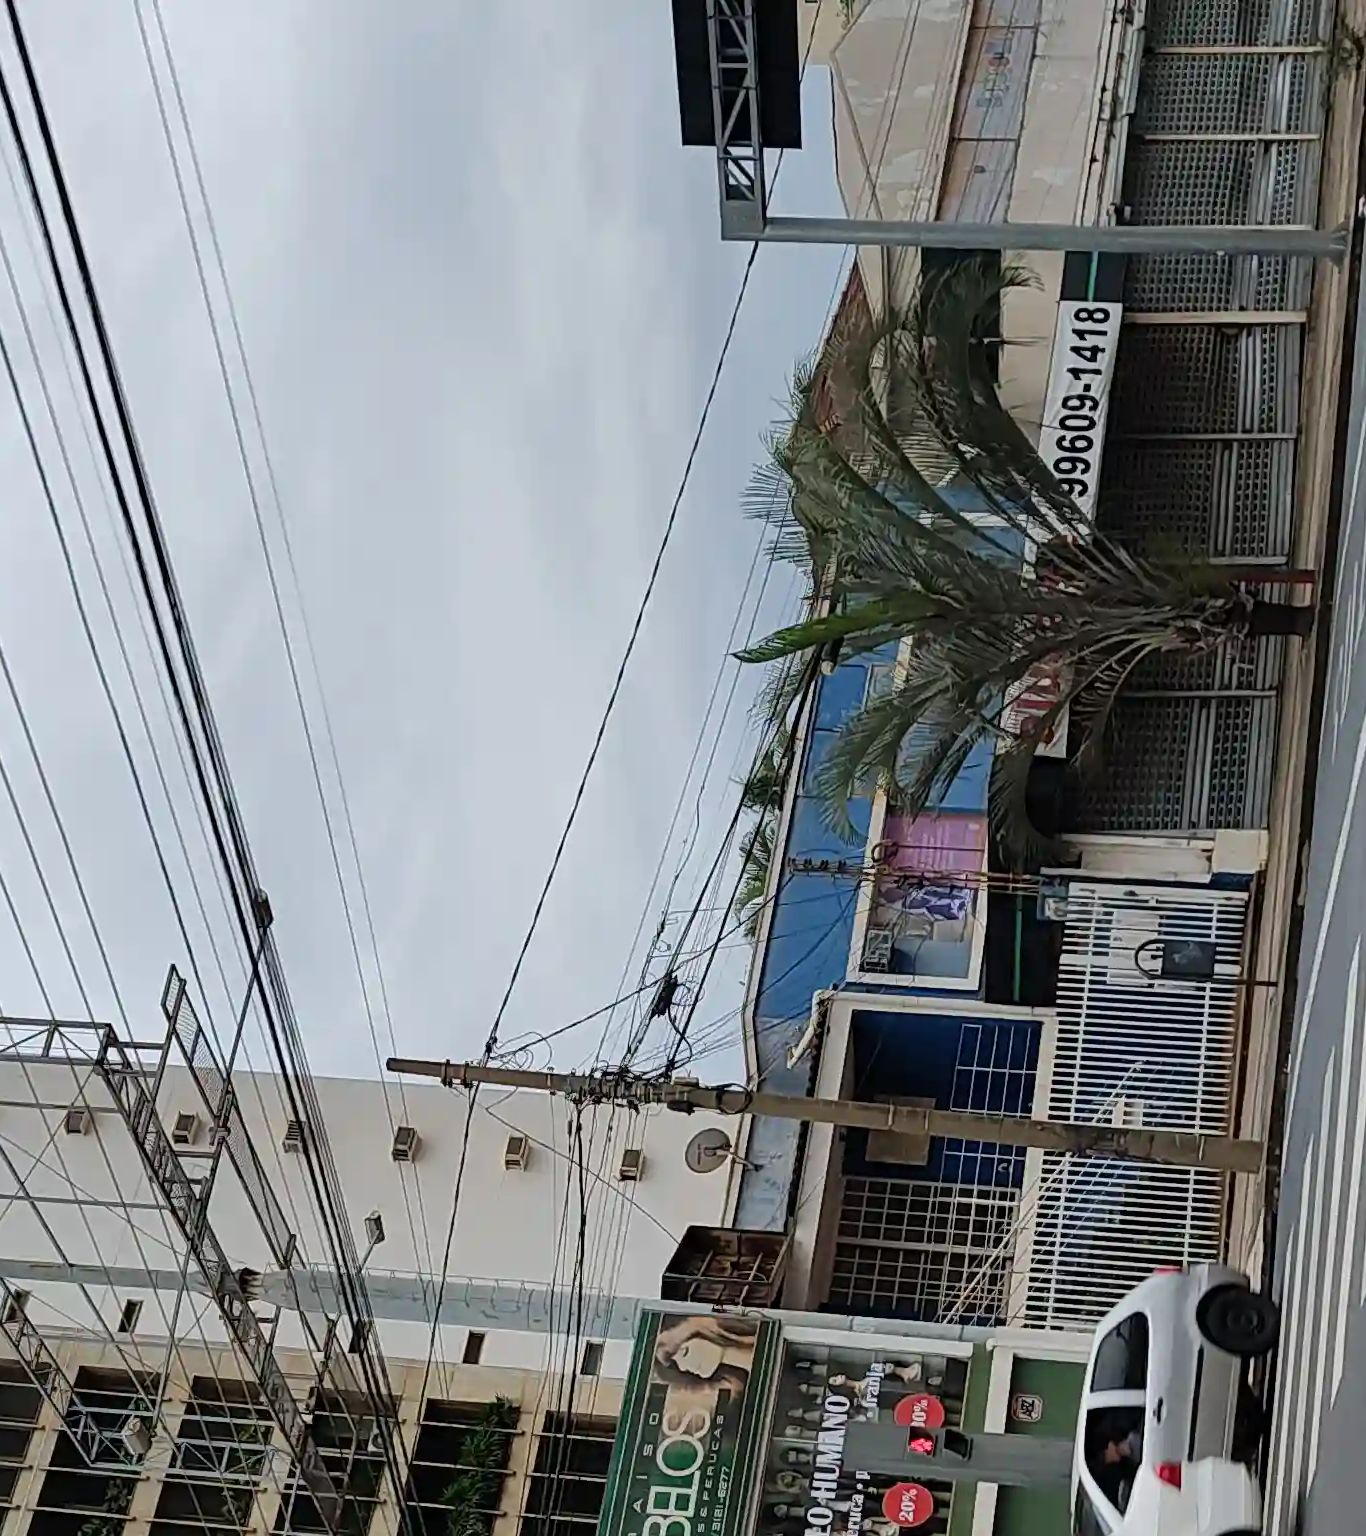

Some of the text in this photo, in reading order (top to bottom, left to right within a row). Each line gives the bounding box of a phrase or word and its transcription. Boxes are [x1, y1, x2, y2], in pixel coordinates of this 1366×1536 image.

[1053, 307, 1111, 498] 99609-1418
[702, 1414, 725, 1501] PERUCAS
[810, 1393, 851, 1500] HUMANO
[699, 1506, 708, 1518] &
[898, 1488, 919, 1522] 20%
